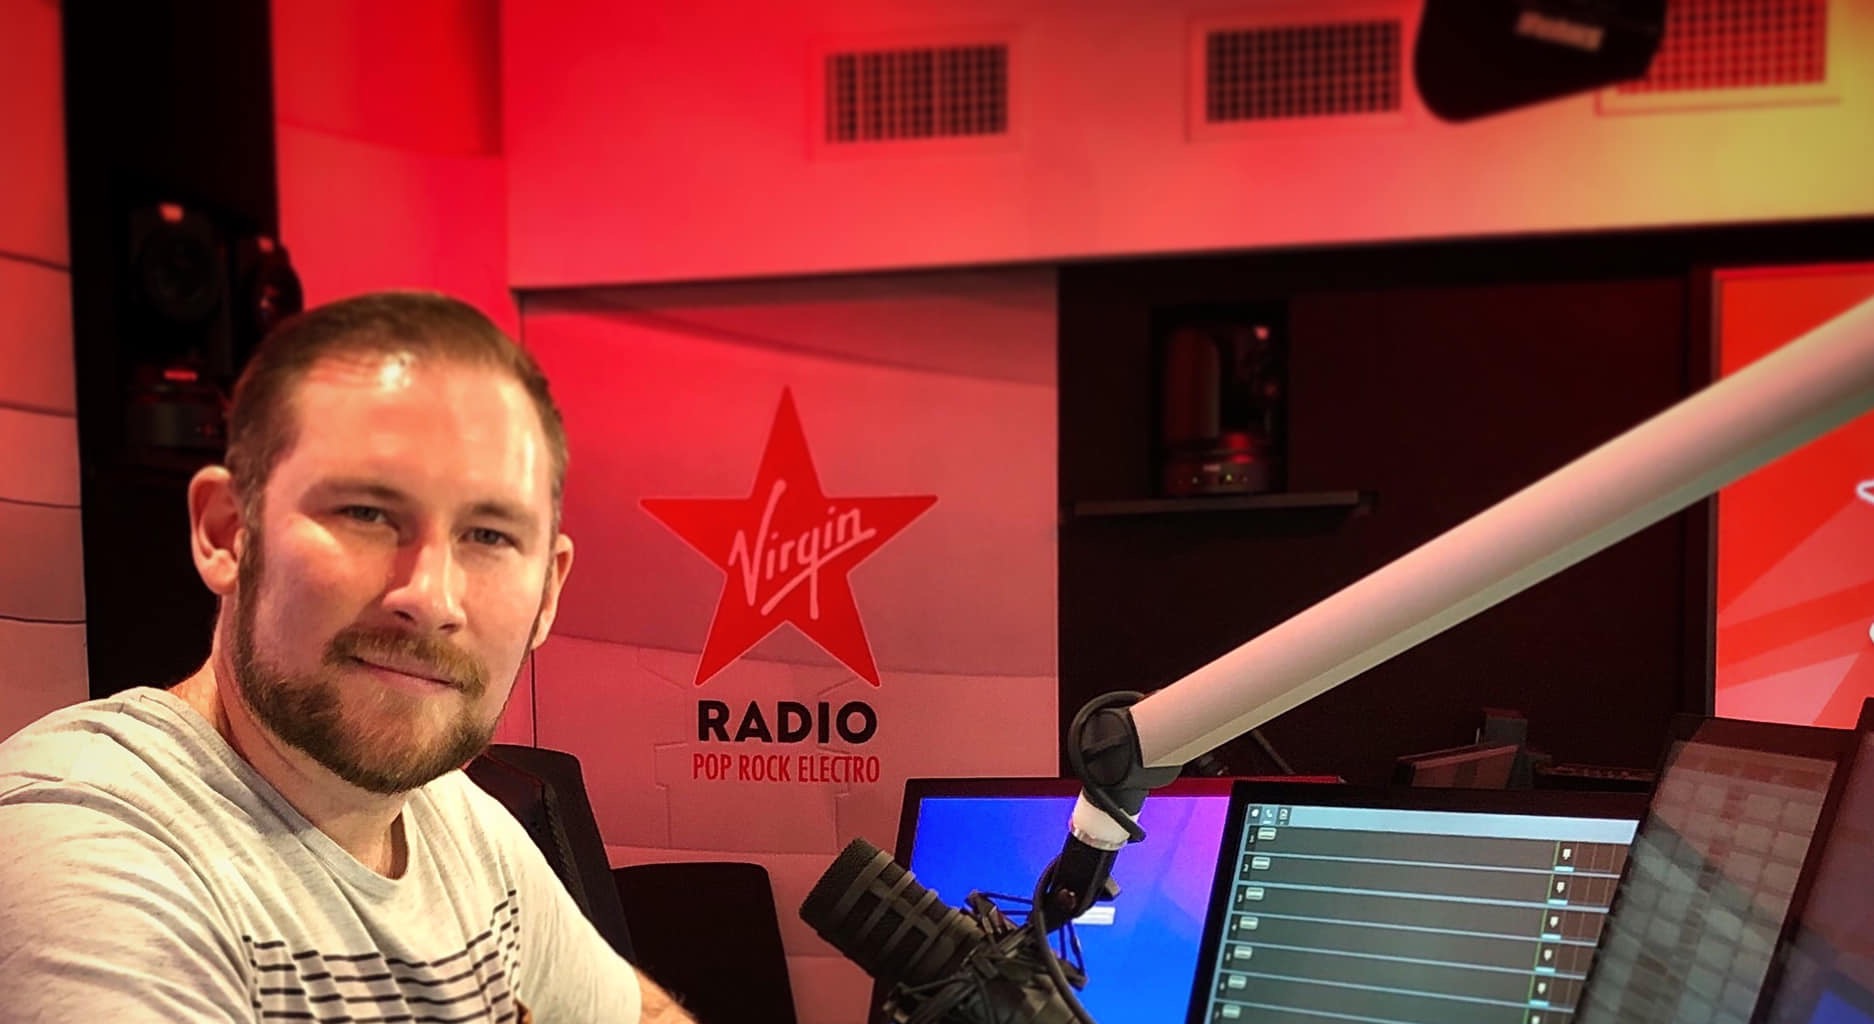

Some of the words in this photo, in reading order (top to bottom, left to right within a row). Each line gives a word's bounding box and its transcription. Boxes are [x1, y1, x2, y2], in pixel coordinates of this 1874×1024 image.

[728, 479, 877, 620] Virgin
[697, 700, 877, 745] RADIO
[693, 753, 732, 781] POP
[738, 755, 790, 782] ROCK
[798, 756, 880, 784] ELECTRO
